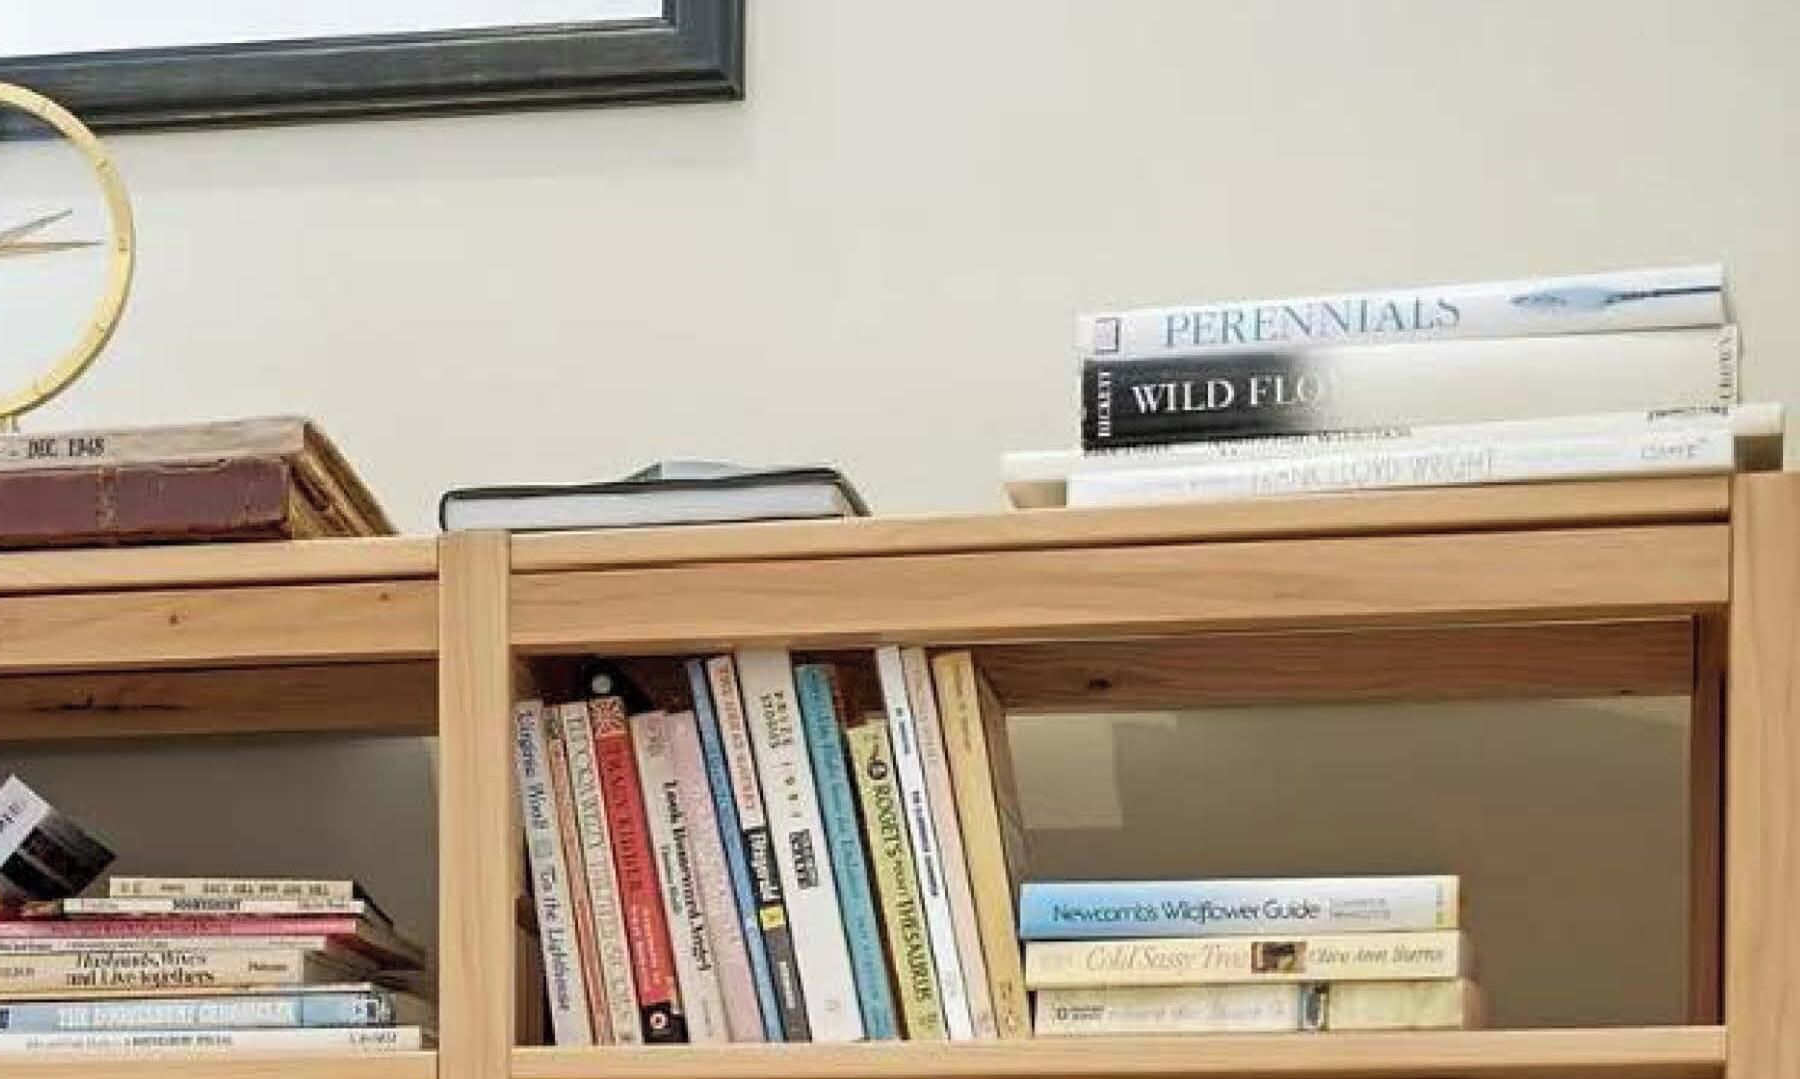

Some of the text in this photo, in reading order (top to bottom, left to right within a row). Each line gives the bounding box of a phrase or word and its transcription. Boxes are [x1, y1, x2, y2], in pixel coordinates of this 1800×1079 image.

[1165, 296, 1460, 348] PERENNIALS
[1131, 380, 1235, 414] WILD
[516, 711, 539, 778] Virginia
[529, 782, 550, 830] Woolf
[544, 898, 559, 921] the
[1165, 900, 1262, 925] Wildflower
[1265, 899, 1321, 920] Guide
[548, 928, 572, 1011] Lighthouse
[896, 899, 933, 1004] THESAURUS
